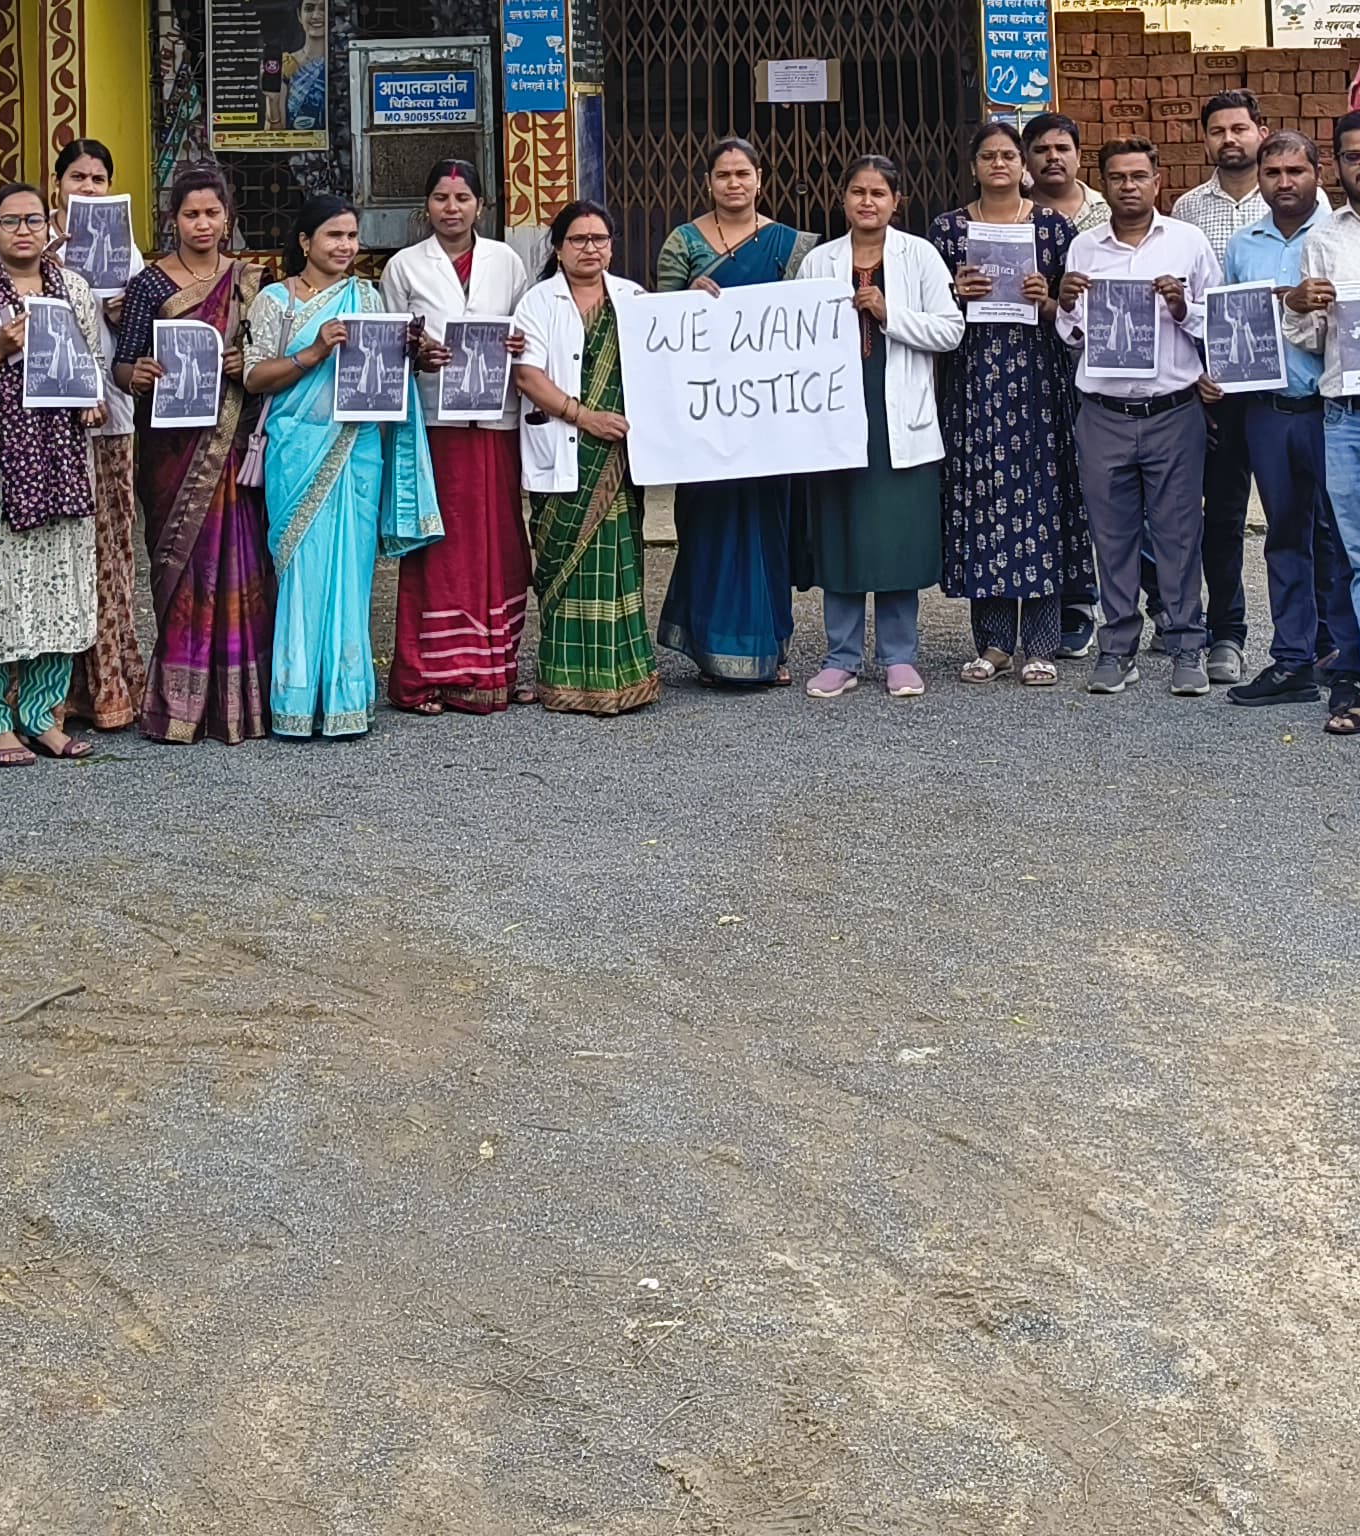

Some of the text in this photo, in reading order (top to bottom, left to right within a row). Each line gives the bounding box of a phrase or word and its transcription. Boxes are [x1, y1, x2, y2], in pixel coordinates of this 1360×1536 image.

[988, 31, 1047, 46] कृपया जूता
[379, 74, 468, 95] आपातकालीन
[389, 95, 458, 108] चिकित्सा सेवा
[74, 205, 127, 225] JUSTICE
[1092, 282, 1153, 304] JUSTICE
[1214, 291, 1268, 317] JUSTICE
[348, 324, 403, 344] JUSTICE
[452, 325, 506, 344] JUSTICE
[645, 296, 855, 353] WE WANT
[161, 329, 213, 352] JUSTICE
[687, 364, 846, 420] JUSTICE
